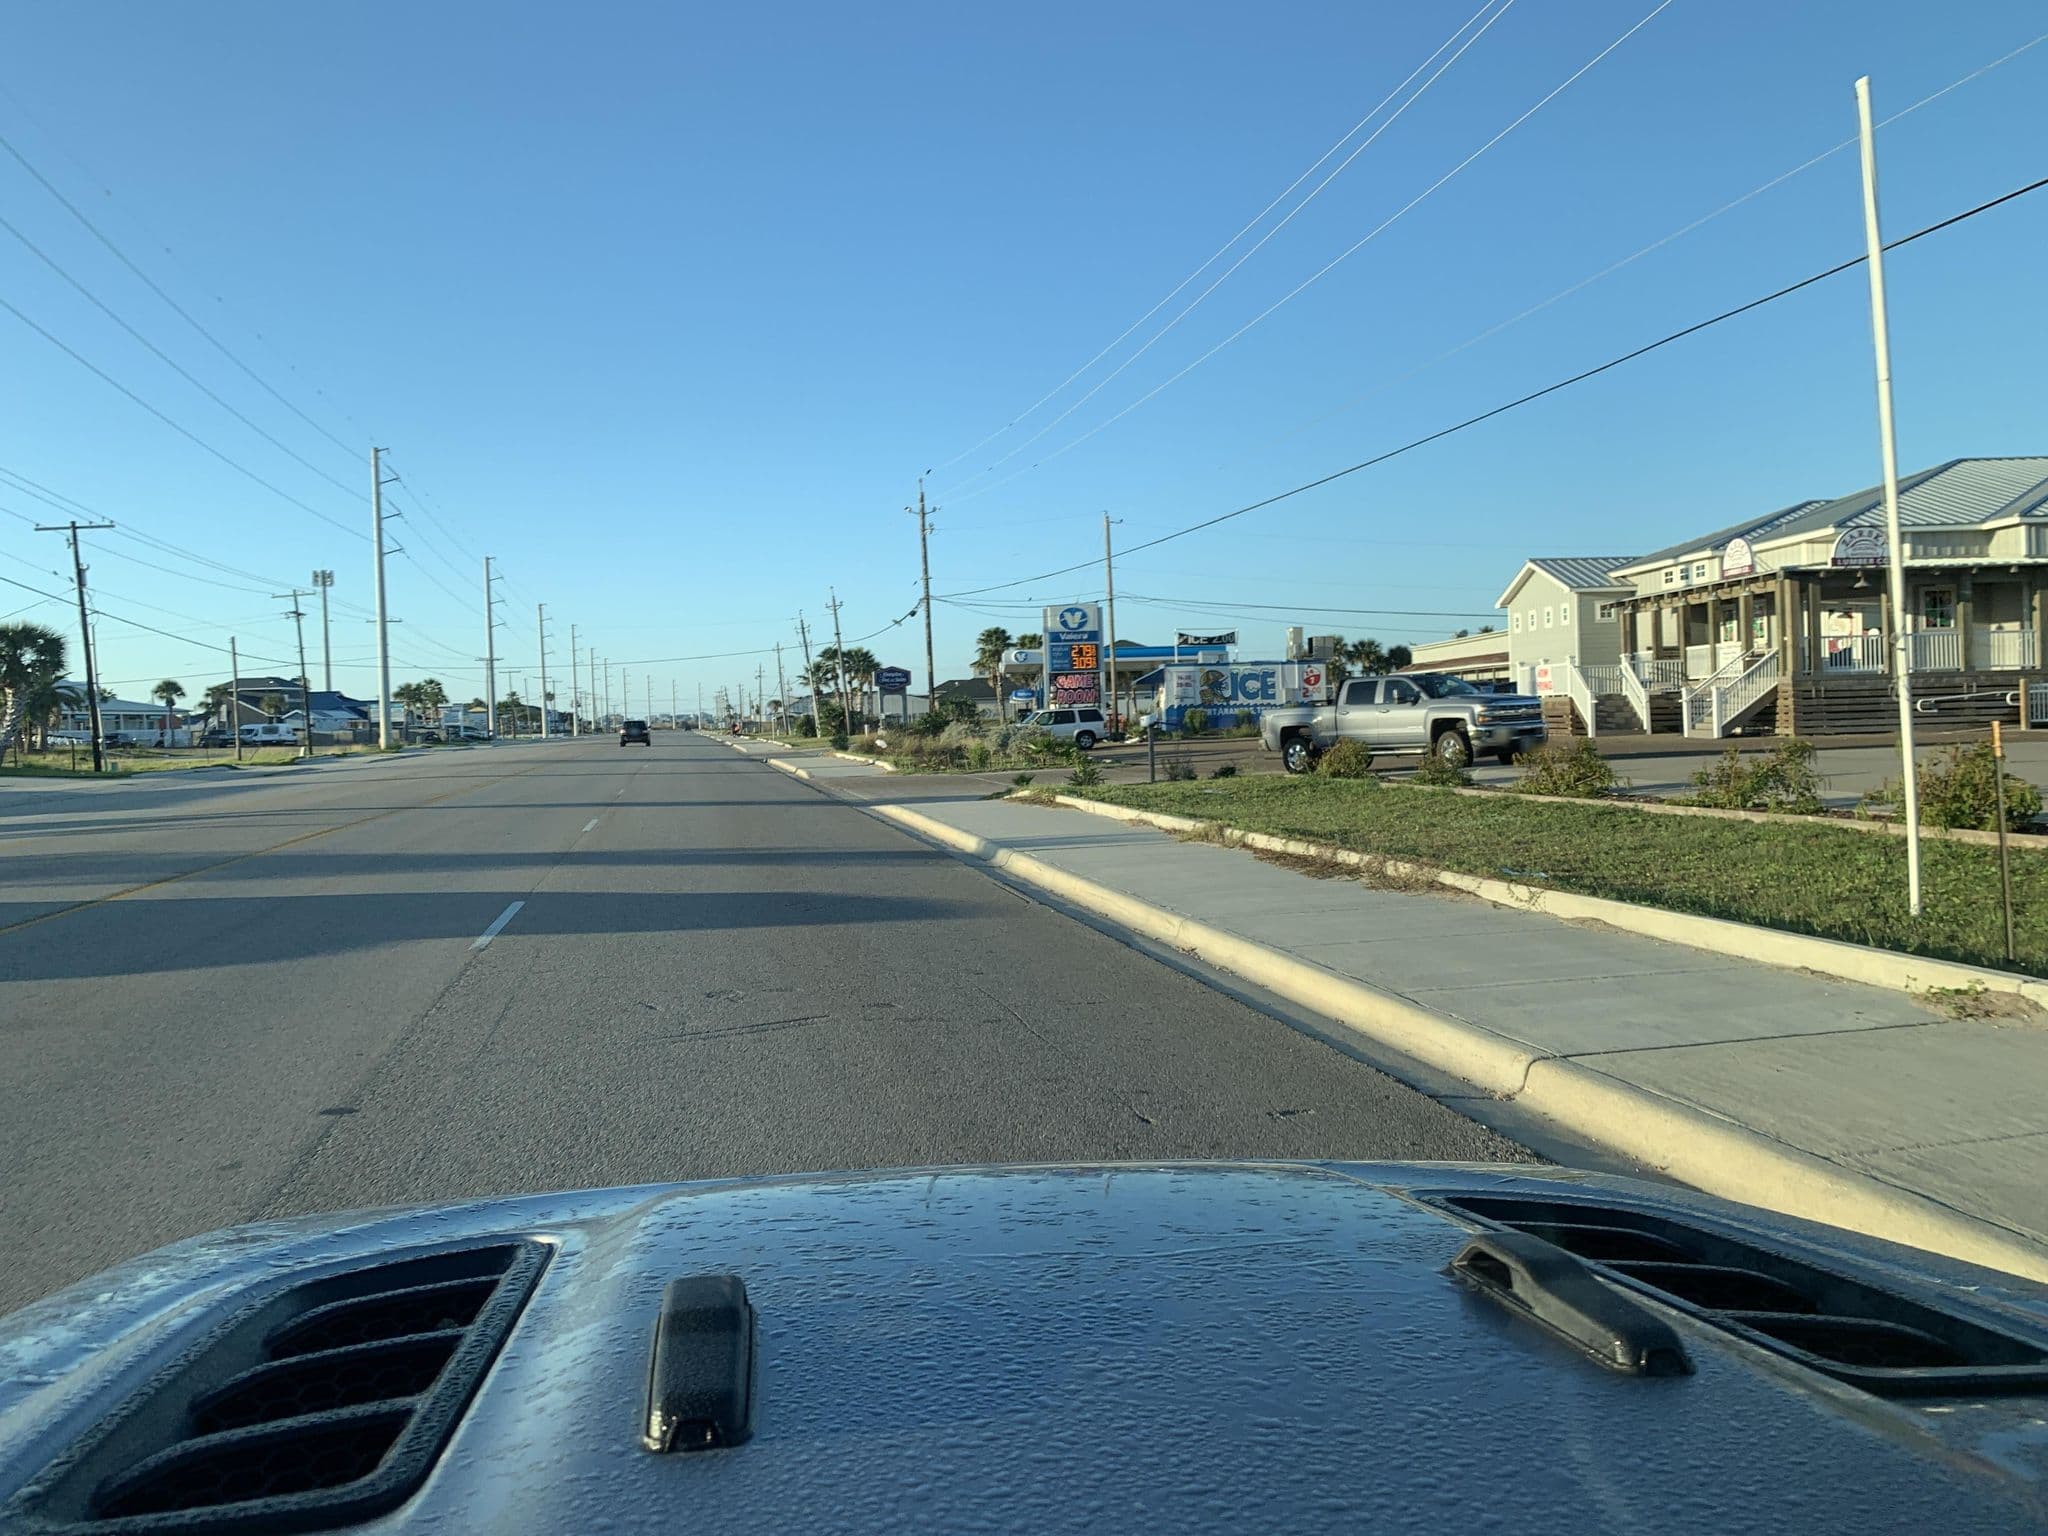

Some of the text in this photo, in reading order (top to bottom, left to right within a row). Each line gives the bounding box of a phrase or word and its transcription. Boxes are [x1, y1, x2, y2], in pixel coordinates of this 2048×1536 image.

[1060, 632, 1088, 641] Valero
[1187, 635, 1209, 645] ICE
[1056, 674, 1094, 689] GAME
[1230, 671, 1276, 701] ICE
[1057, 689, 1097, 704] ROOM
